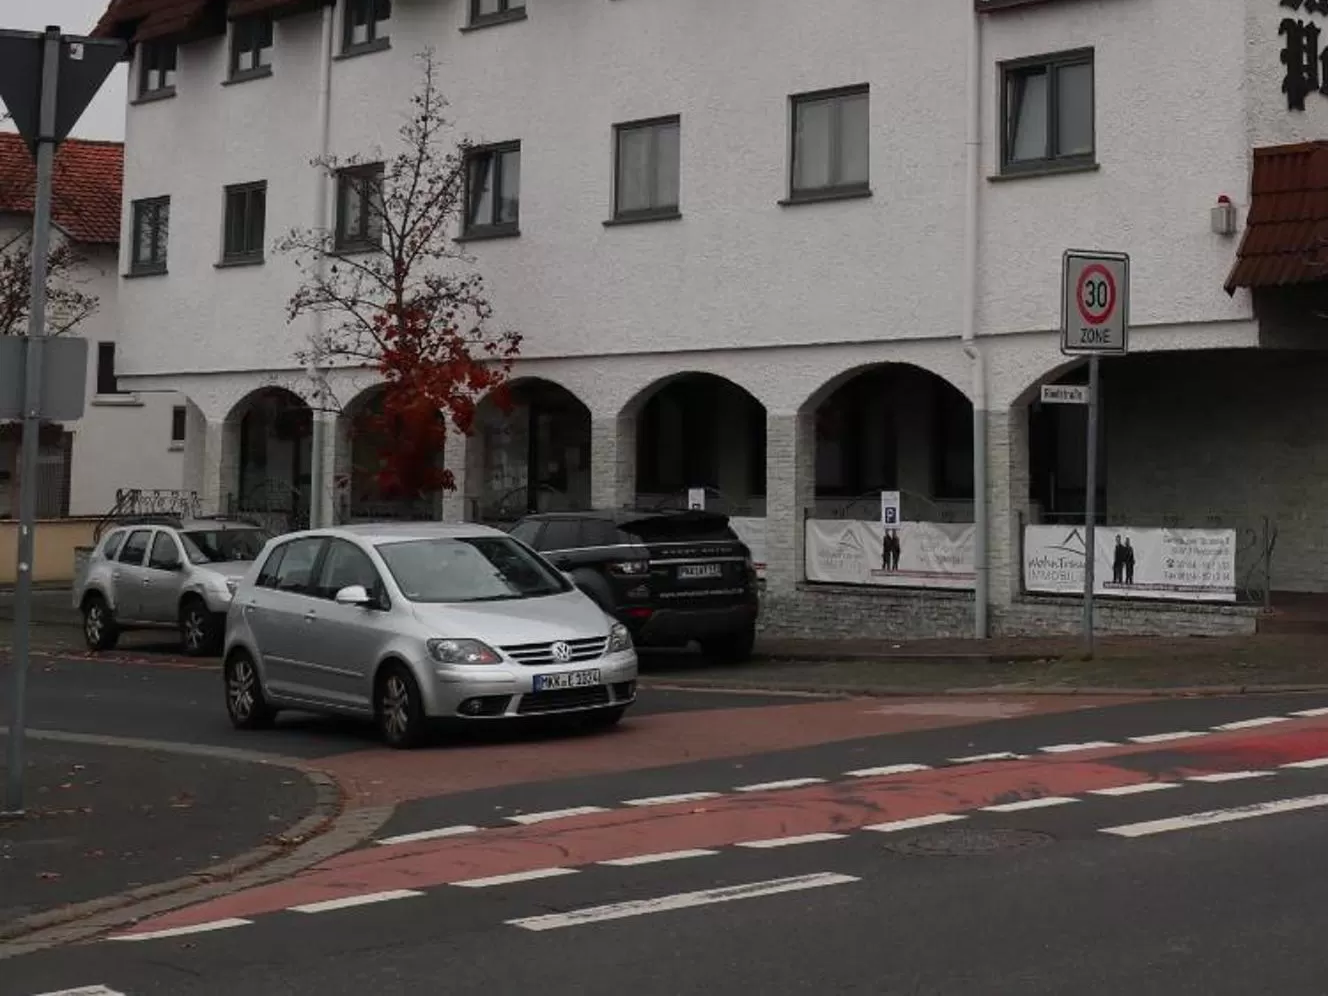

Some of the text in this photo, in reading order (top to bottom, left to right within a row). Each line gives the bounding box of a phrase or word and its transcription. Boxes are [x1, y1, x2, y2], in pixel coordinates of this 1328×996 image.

[1084, 280, 1107, 308] 30
[1080, 328, 1112, 344] ZONE
[886, 508, 896, 523] P
